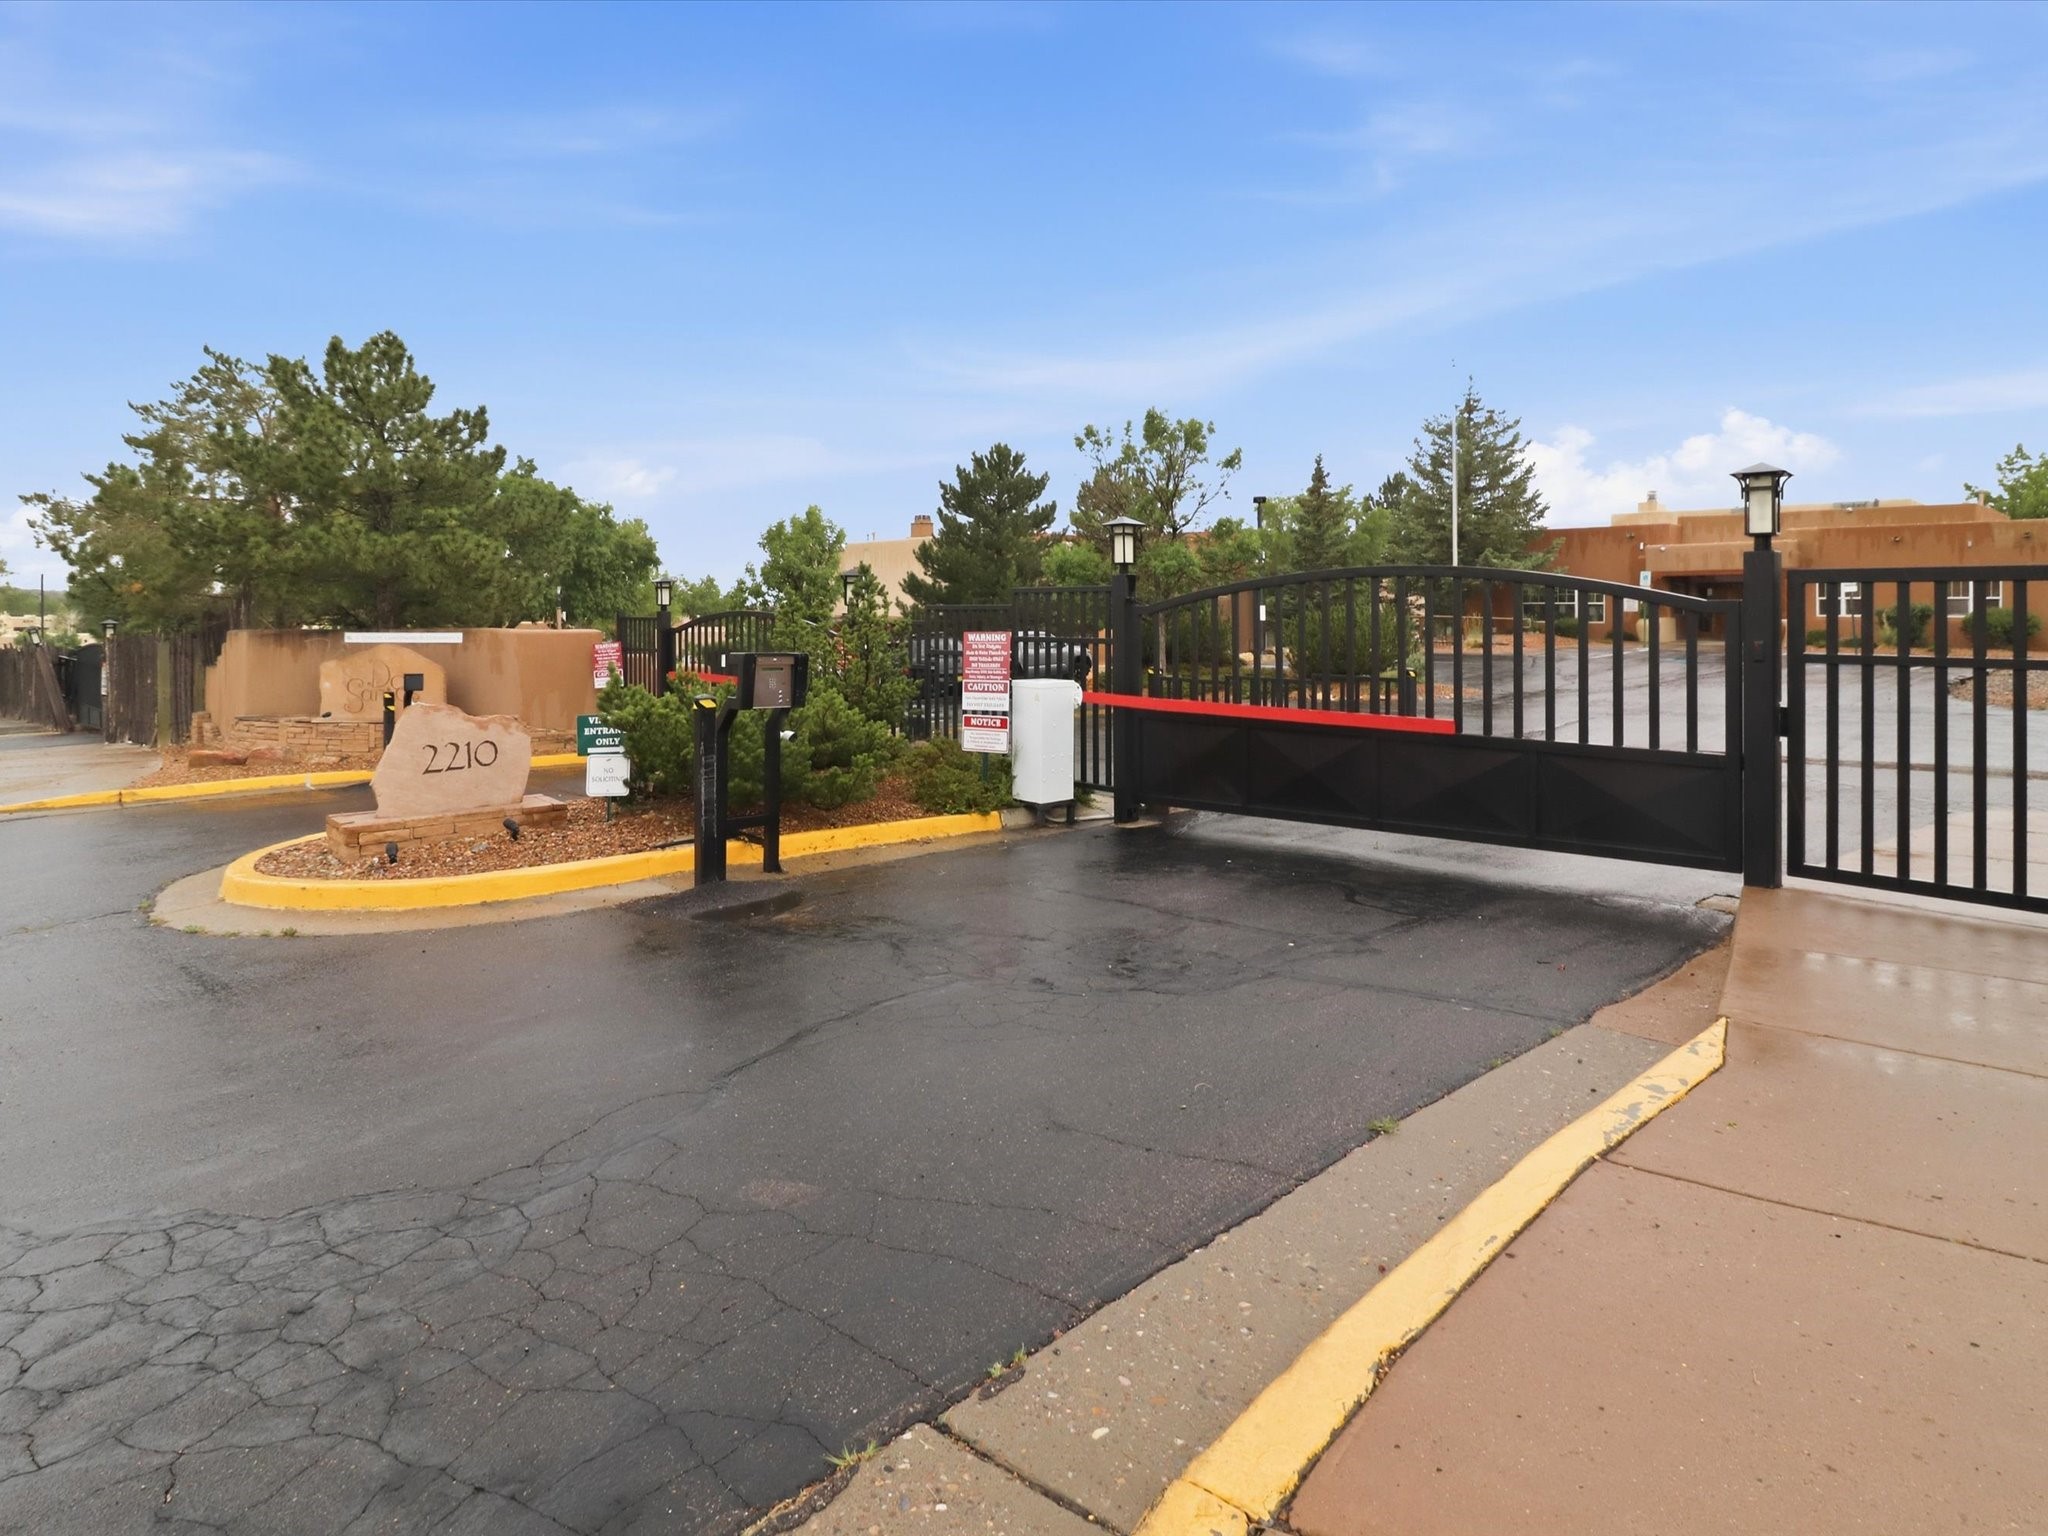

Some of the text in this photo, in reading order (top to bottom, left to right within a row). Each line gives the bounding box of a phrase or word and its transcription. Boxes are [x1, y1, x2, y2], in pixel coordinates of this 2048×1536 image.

[967, 633, 1007, 642] WARNING
[967, 683, 1004, 692] CAUTION
[970, 717, 1002, 727] NOTICE
[584, 727, 628, 736] ENTRAN
[595, 737, 621, 746] ONLY
[422, 740, 499, 775] 2210
